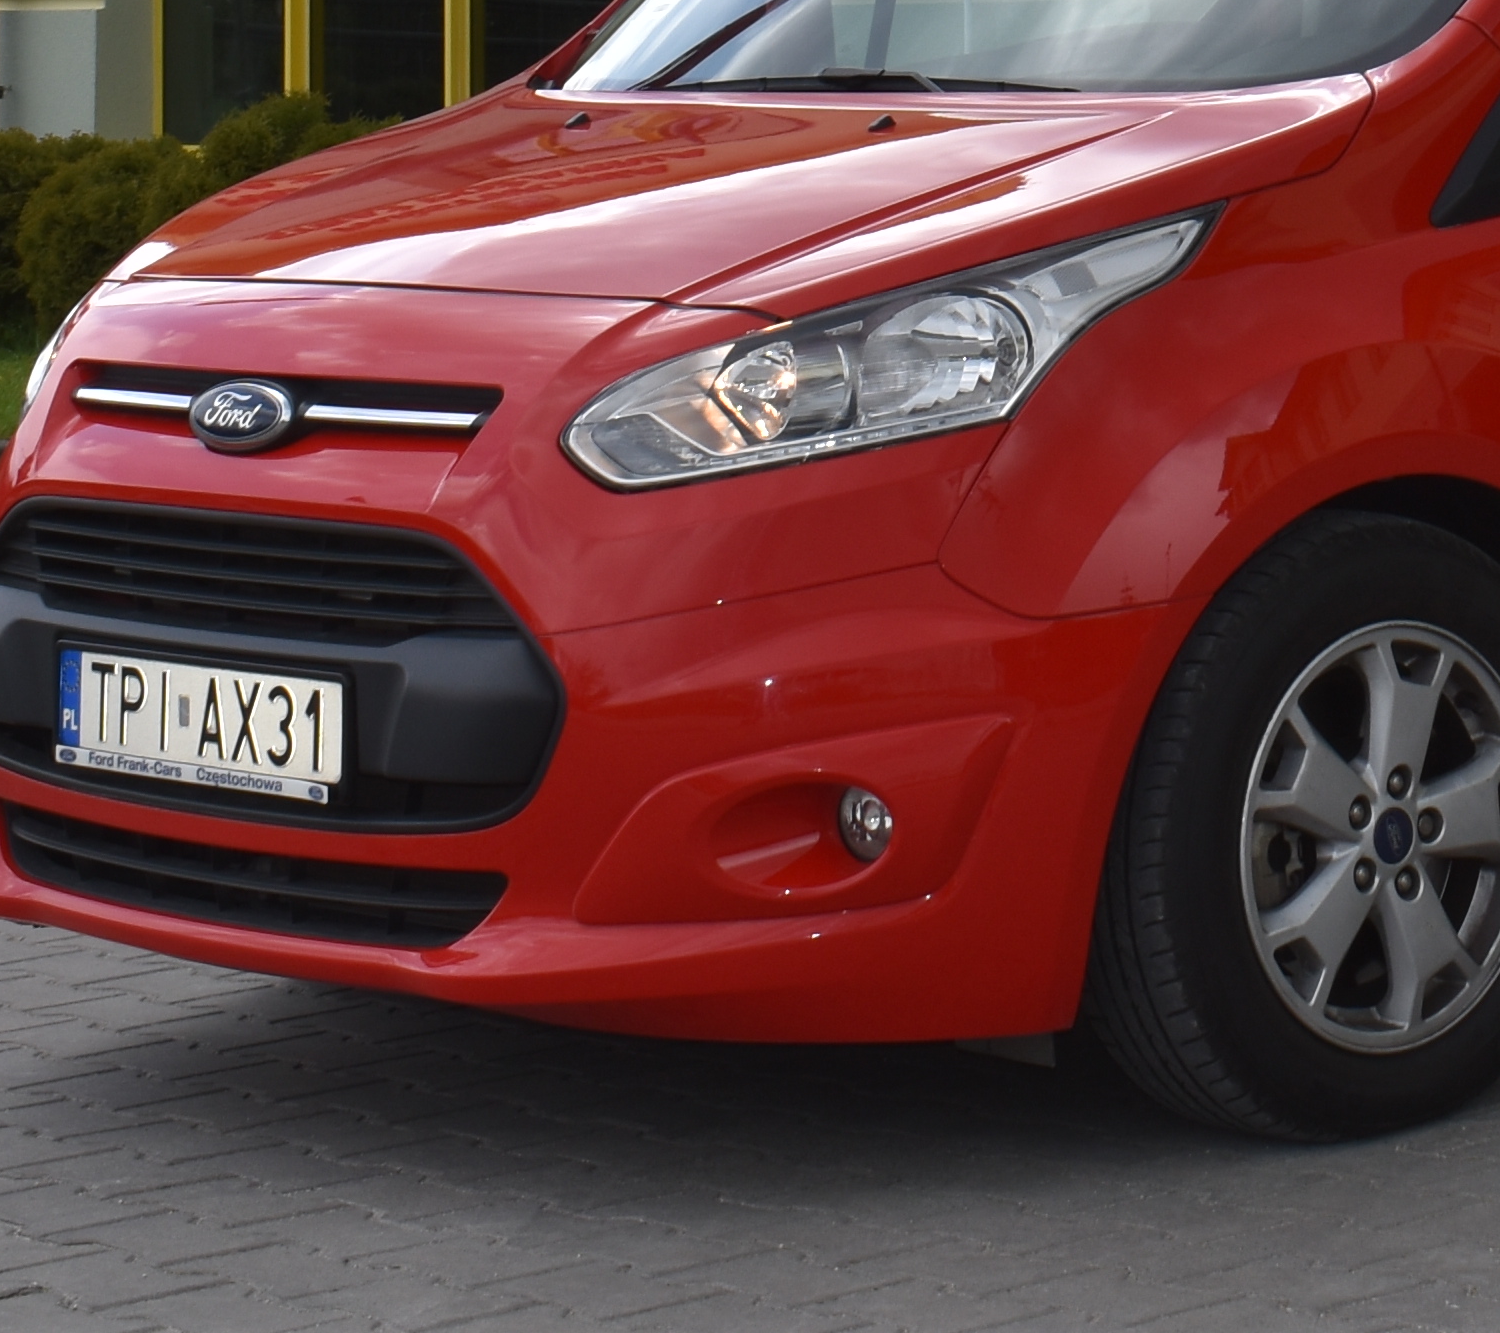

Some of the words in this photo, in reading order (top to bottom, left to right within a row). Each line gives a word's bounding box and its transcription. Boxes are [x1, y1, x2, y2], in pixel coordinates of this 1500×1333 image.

[203, 391, 263, 430] Ford
[62, 707, 78, 731] PL
[91, 661, 172, 753] TPI
[197, 675, 326, 773] AX31
[88, 751, 115, 768] Ford
[116, 755, 182, 778] Frank-Cars
[195, 767, 284, 792] Częstochowa
